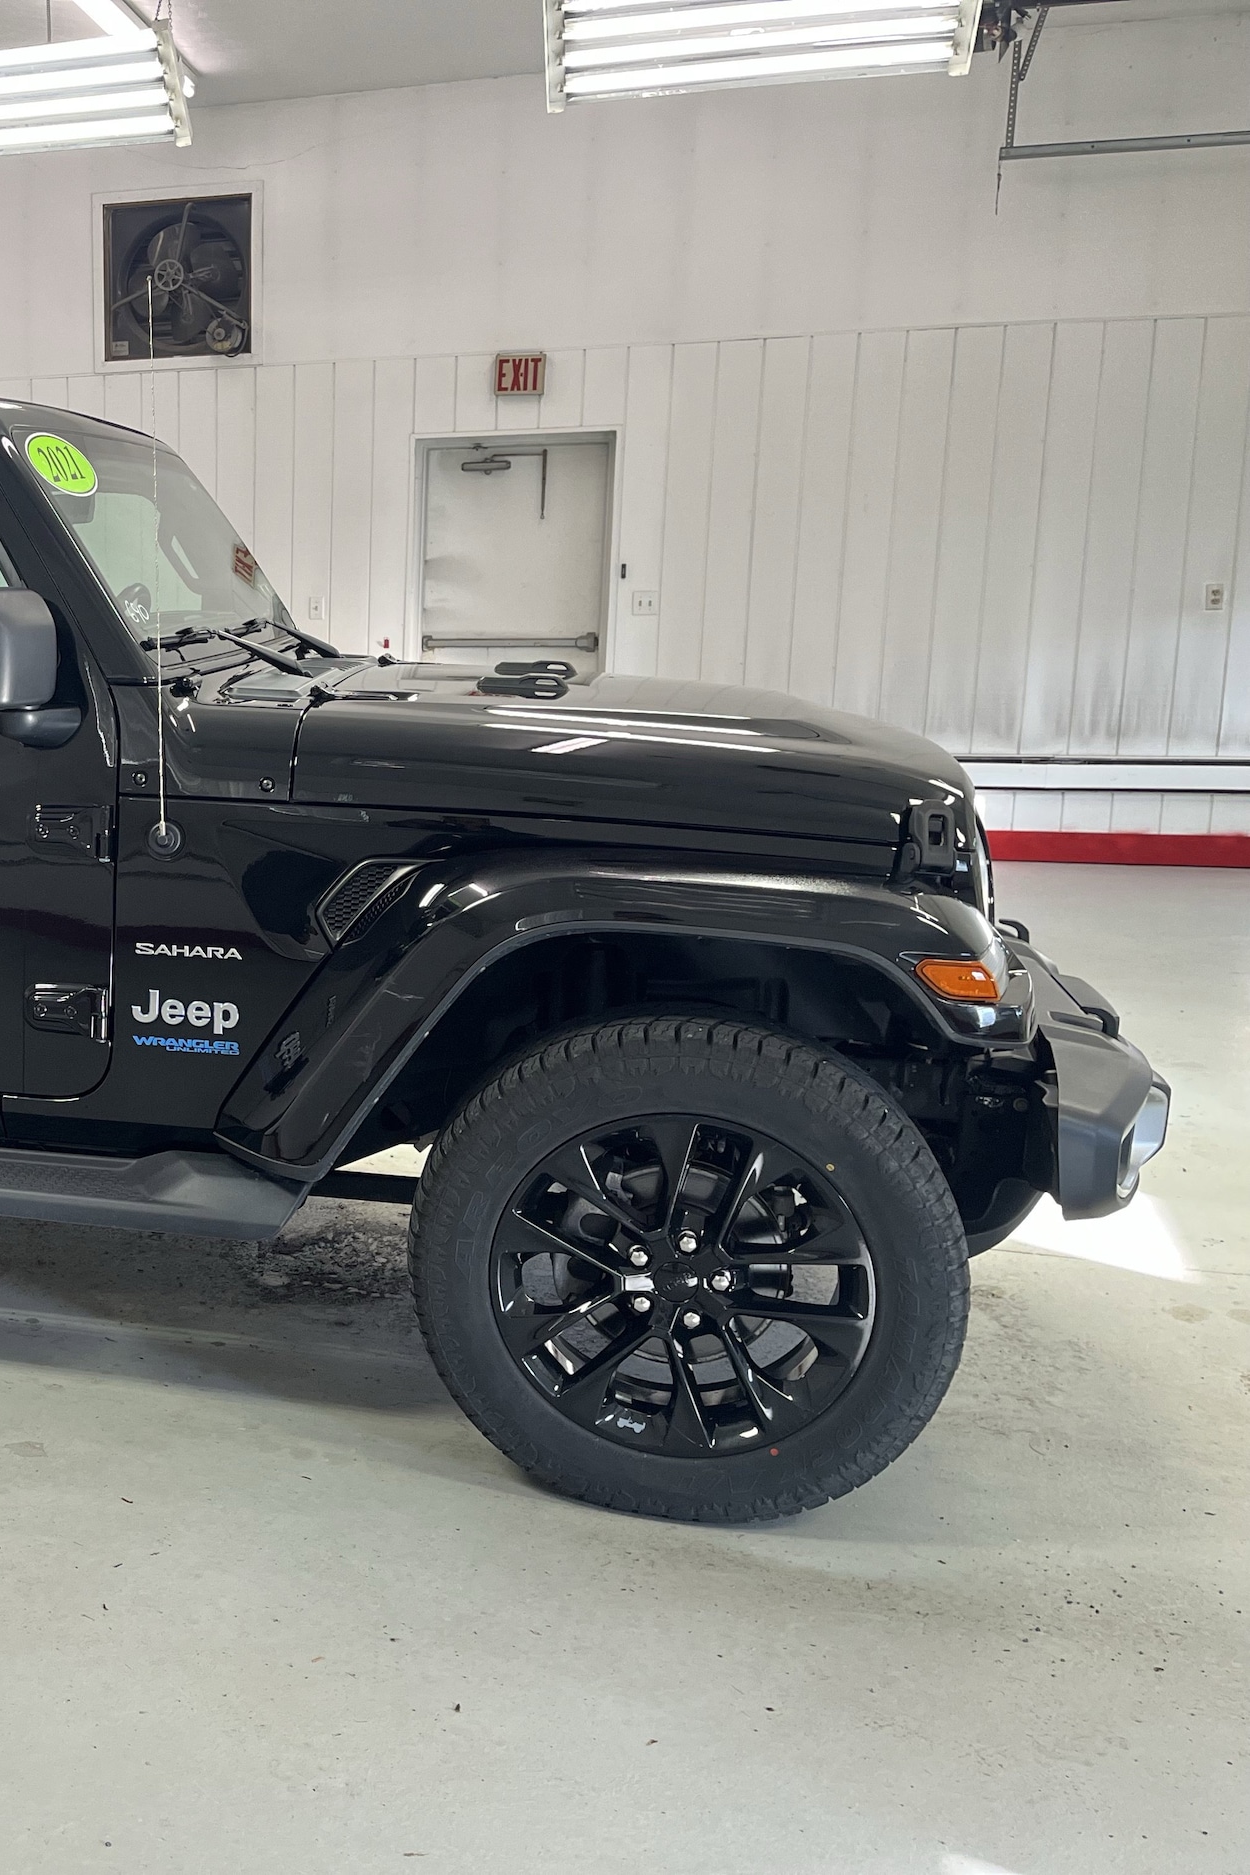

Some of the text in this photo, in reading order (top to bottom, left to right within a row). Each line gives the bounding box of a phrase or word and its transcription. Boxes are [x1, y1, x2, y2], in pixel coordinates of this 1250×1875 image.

[496, 357, 543, 392] EXIT
[37, 445, 87, 483] 2021
[135, 942, 243, 960] SAHARA
[131, 988, 240, 1035] Jeep
[133, 1035, 239, 1051] WRANGLER
[166, 1046, 240, 1056] UNLIMITED
